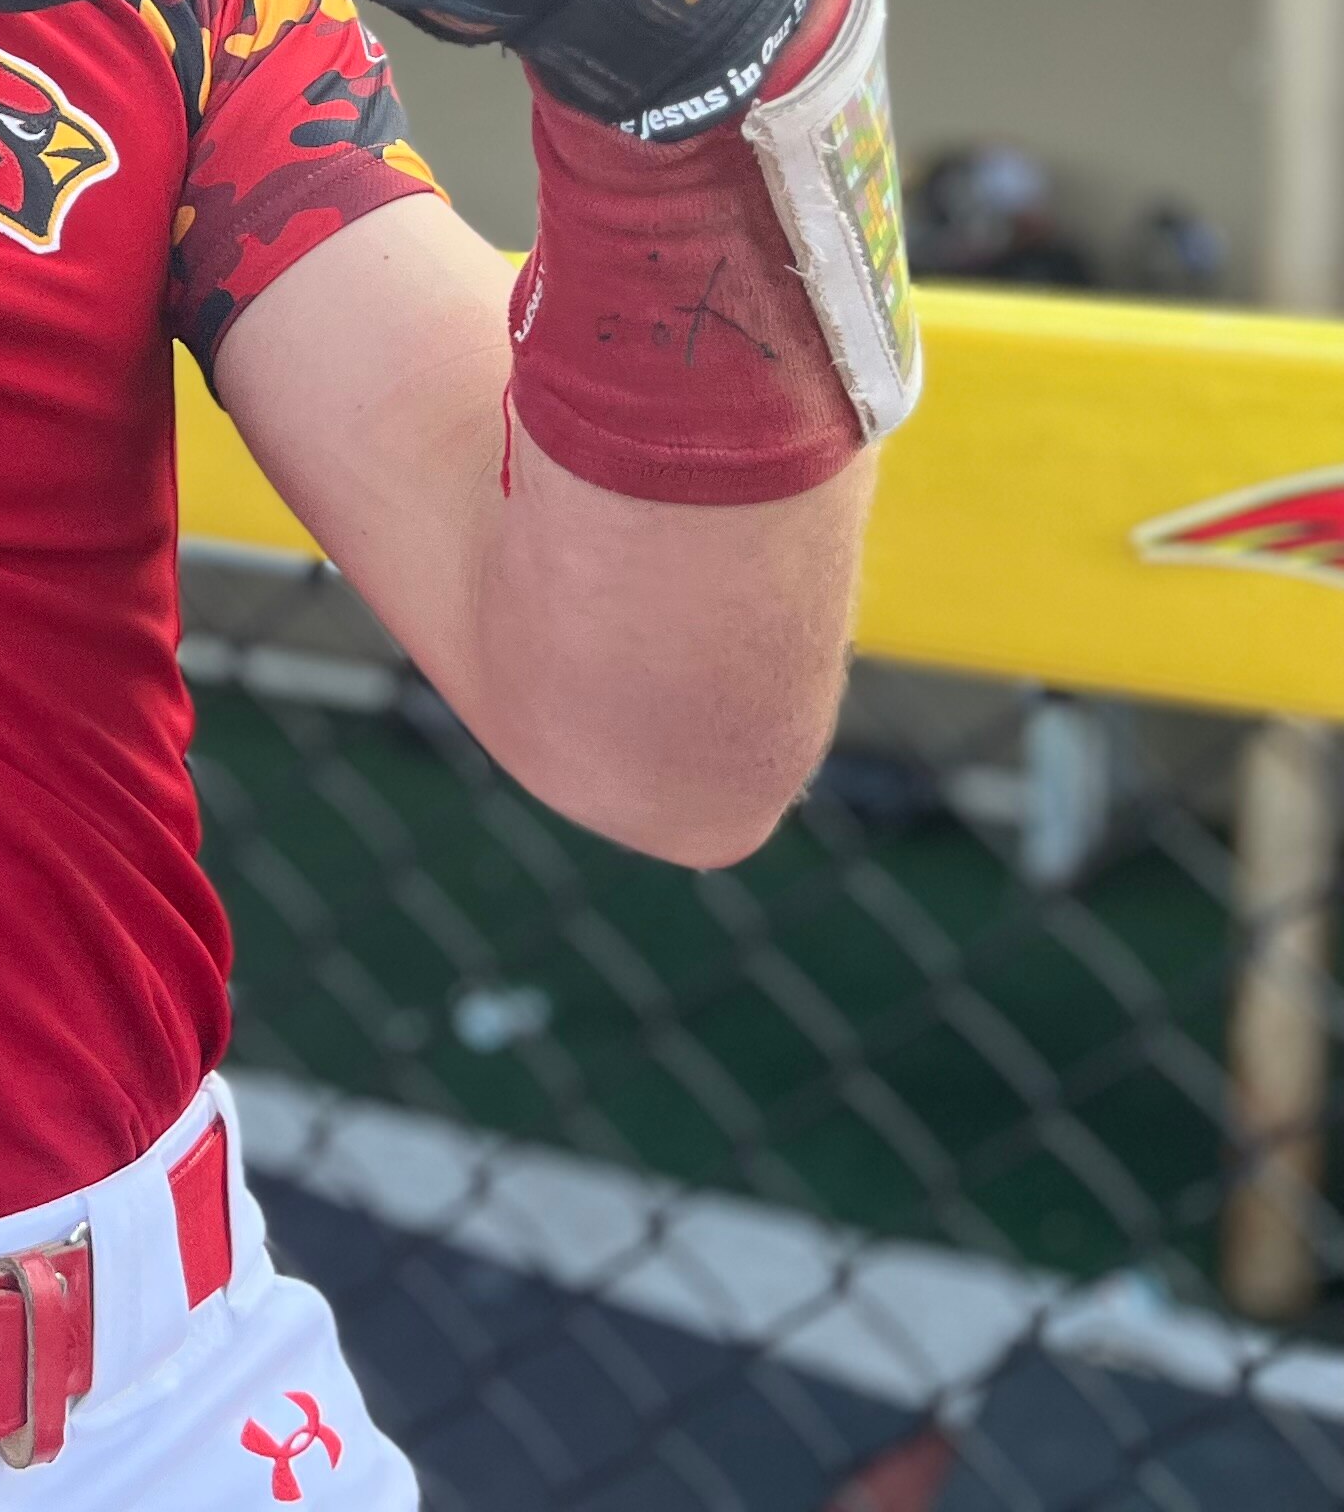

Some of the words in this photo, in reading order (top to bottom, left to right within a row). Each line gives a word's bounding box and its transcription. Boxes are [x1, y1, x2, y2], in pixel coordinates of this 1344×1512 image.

[640, 86, 728, 140] Jesus
[727, 62, 762, 97] in
[761, 14, 793, 65] Our
